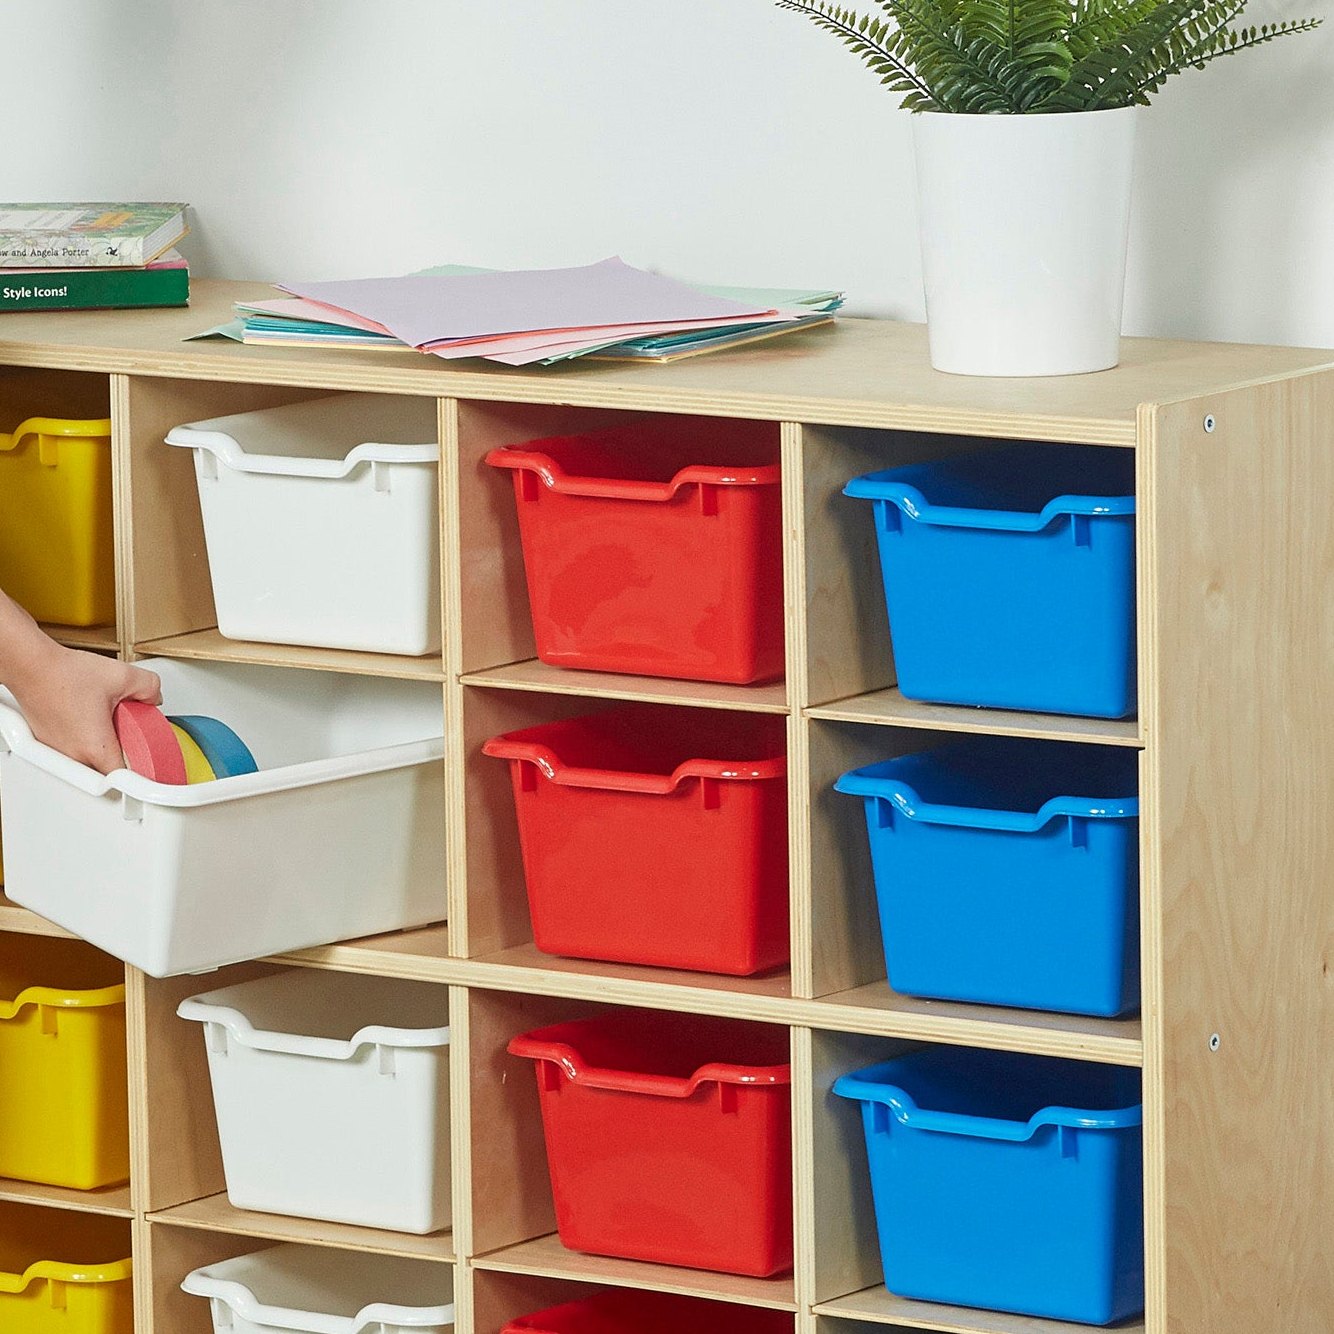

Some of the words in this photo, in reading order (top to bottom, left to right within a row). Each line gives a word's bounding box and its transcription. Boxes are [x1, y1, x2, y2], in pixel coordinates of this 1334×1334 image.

[11, 248, 27, 257] and
[30, 248, 59, 258] Angela
[62, 247, 89, 257] Porter
[3, 286, 32, 301] Style
[34, 286, 68, 298] Icons!
